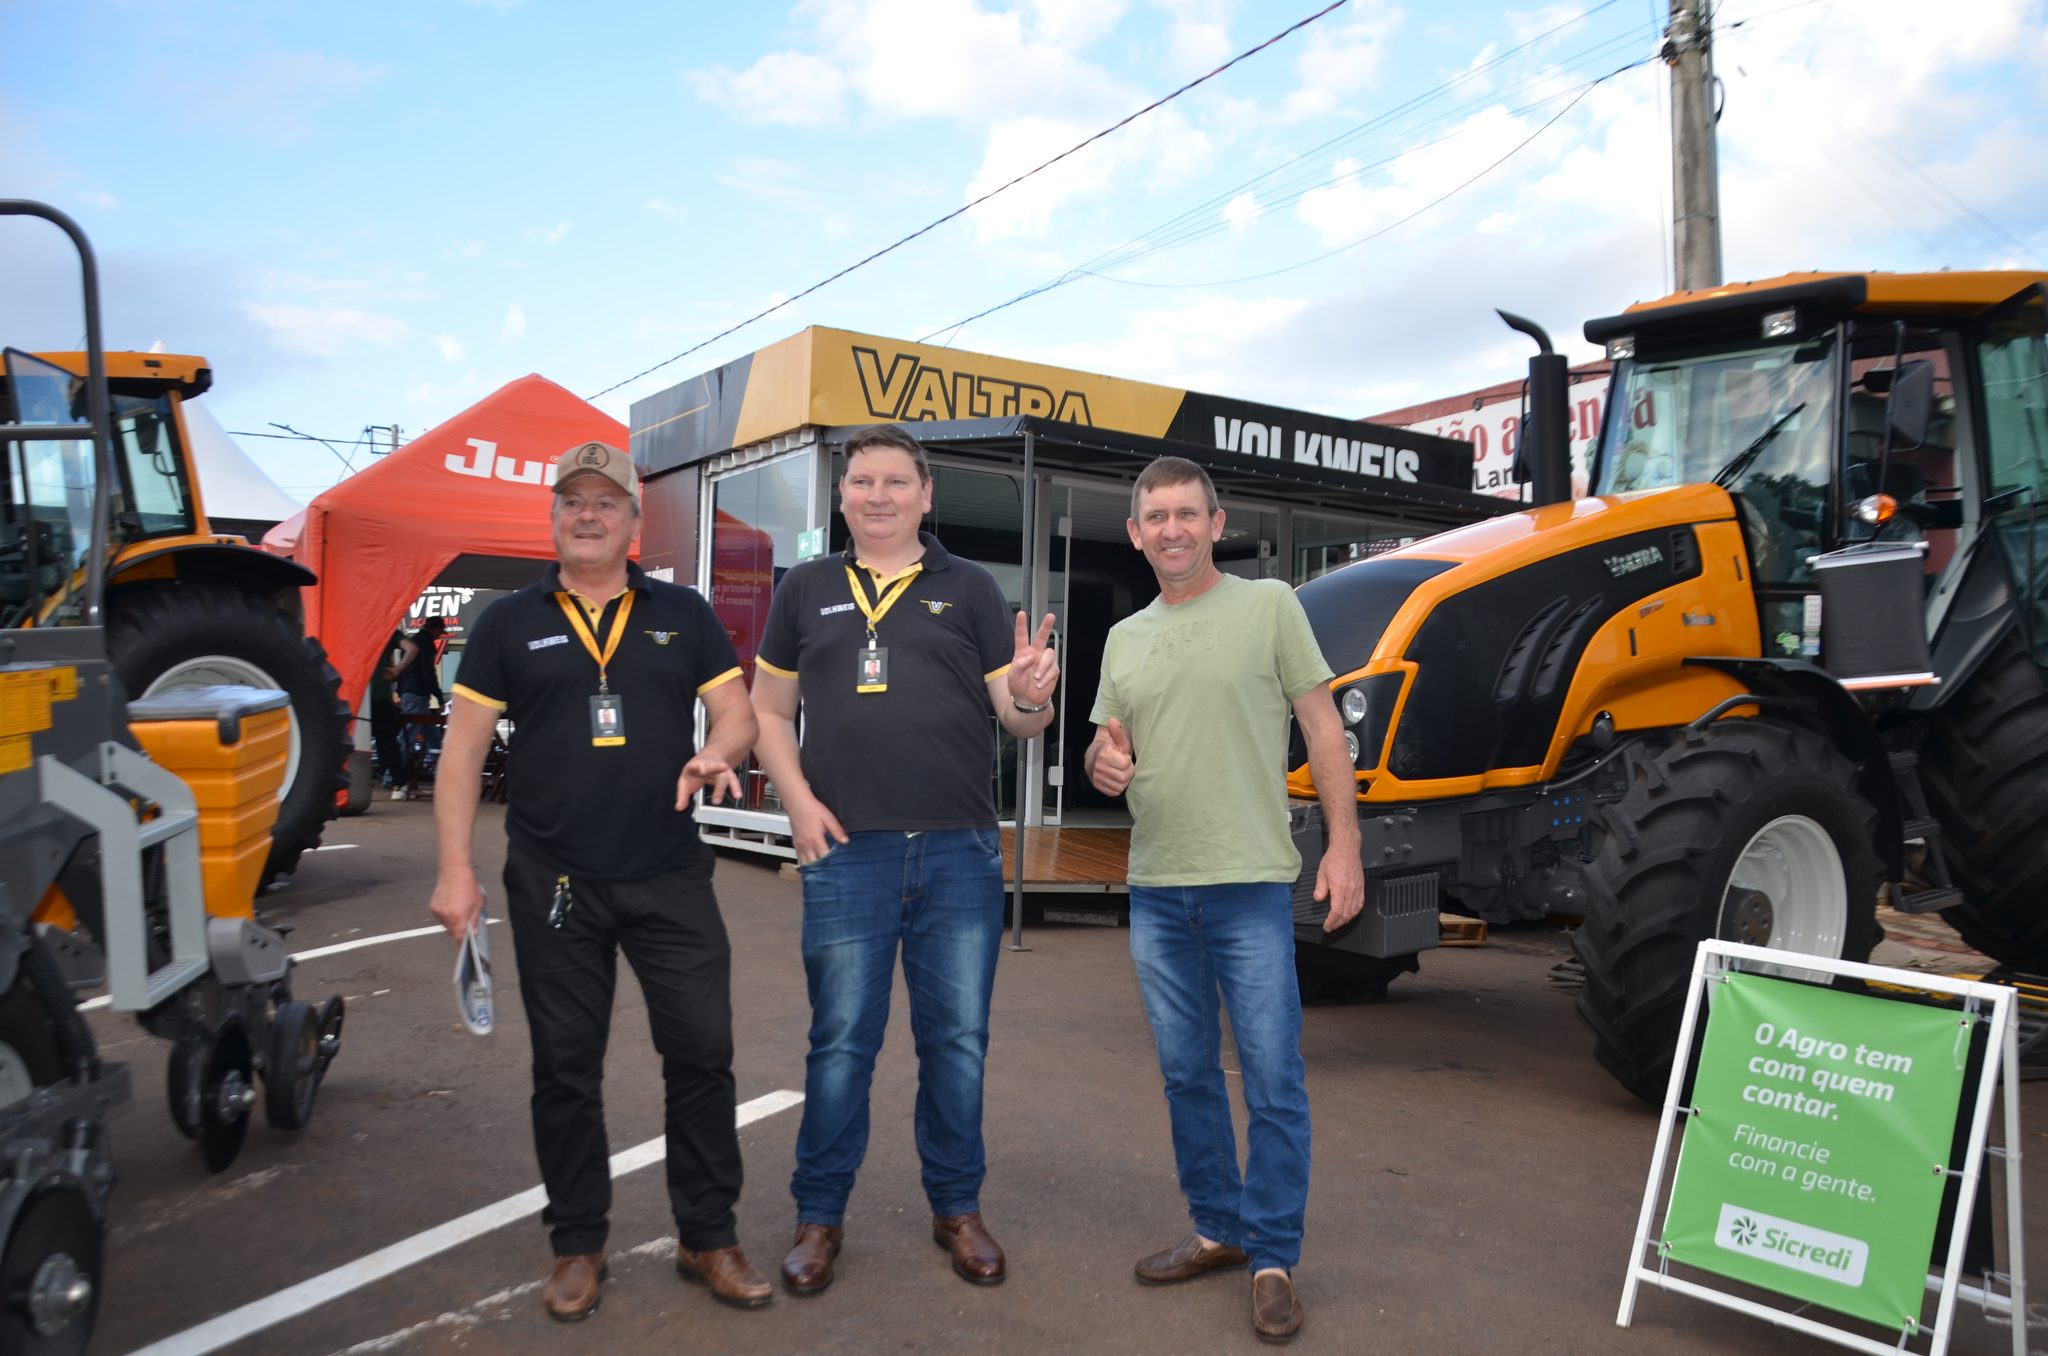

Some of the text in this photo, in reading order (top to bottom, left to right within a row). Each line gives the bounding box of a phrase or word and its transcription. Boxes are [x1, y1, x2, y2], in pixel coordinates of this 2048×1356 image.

[851, 345, 1093, 427] VALTRA
[1754, 1022, 1913, 1074] O Agro tem
[1748, 1056, 1895, 1102] com quem
[1742, 1084, 1838, 1121] contar.
[1733, 1123, 1831, 1164] Financie
[1729, 1152, 1876, 1202] com a gente.
[1761, 1227, 1853, 1271] Sicredi
